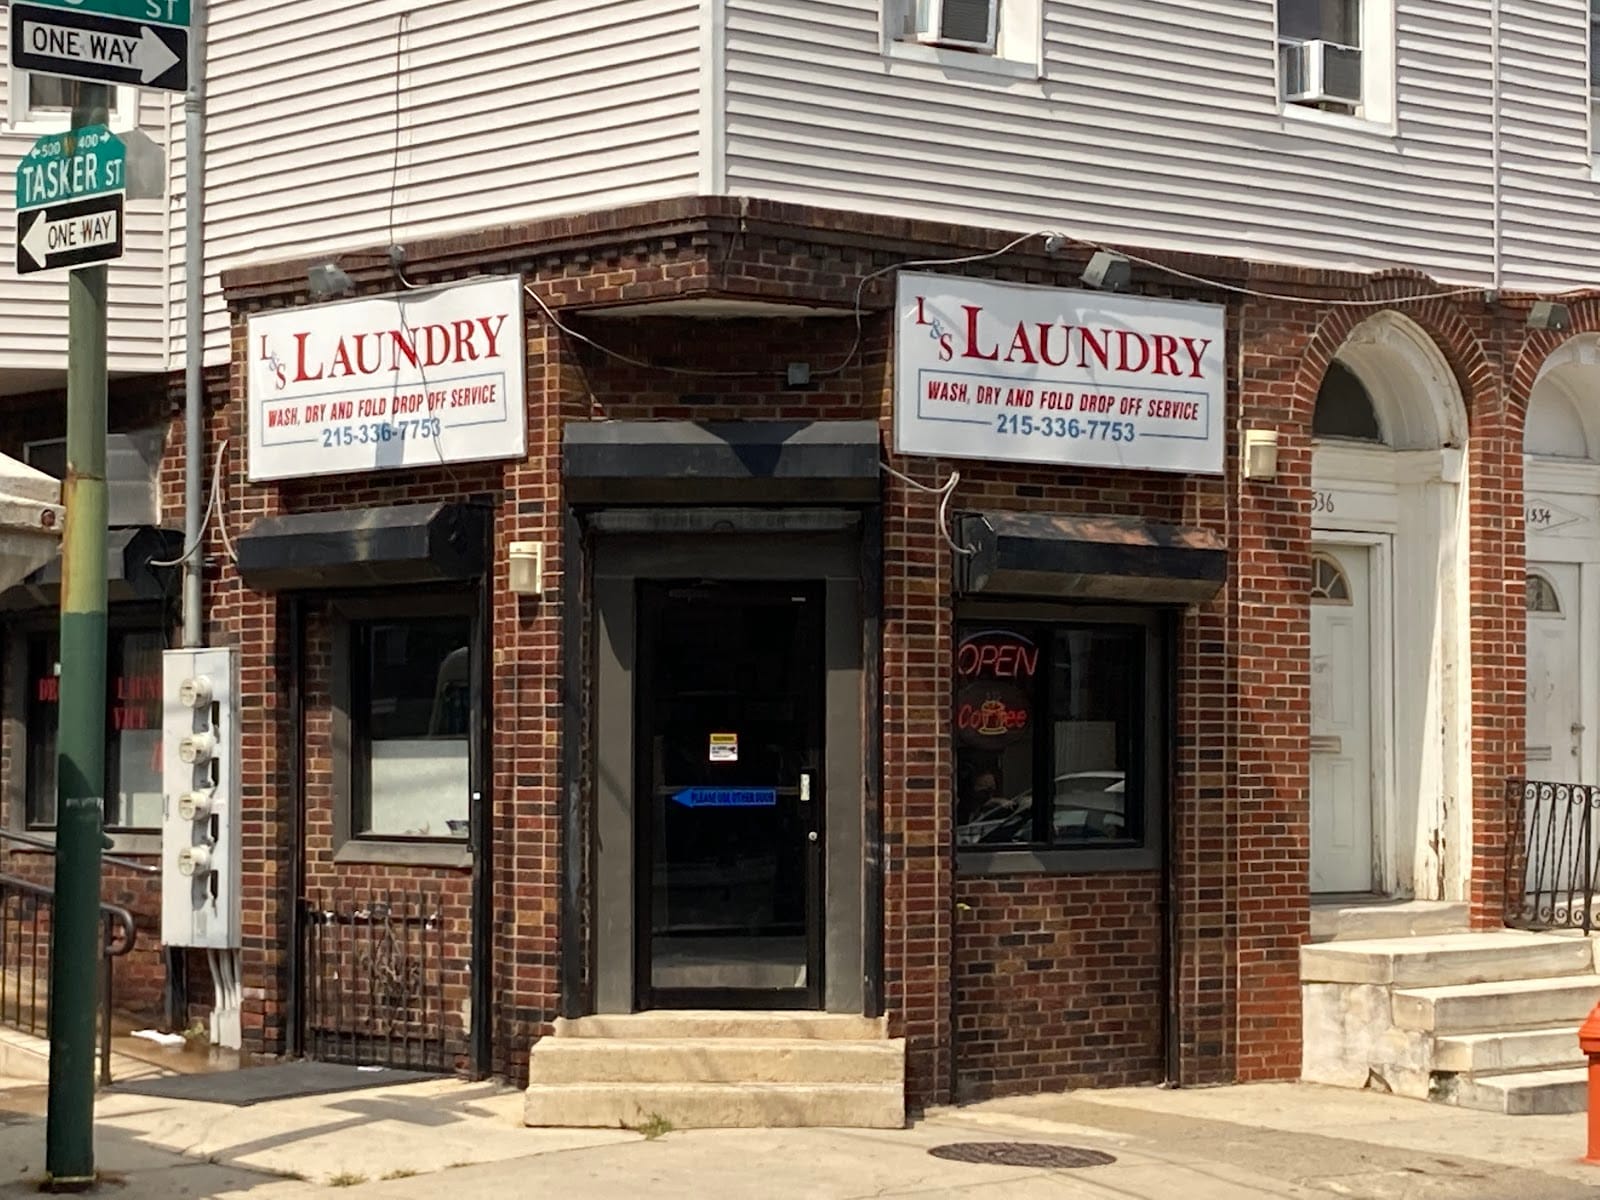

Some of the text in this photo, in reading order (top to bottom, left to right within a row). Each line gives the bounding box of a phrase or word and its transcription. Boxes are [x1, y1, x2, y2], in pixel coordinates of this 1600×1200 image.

[33, 27, 138, 64] ONE WAY
[42, 134, 99, 158] 500 400
[23, 153, 122, 203] TASKER ST
[48, 215, 112, 250] ONE WAY
[292, 314, 509, 383] LAUNDRY
[961, 305, 1212, 379] LAUNDRY
[268, 384, 496, 428] WASH, DRY AND FOLD DROP OFF SERVICE
[928, 380, 1199, 421] WASH, DRY AND FOLD DROP OFF SERVICE
[323, 417, 441, 448] 215-336-7753
[997, 413, 1135, 442] 215-336-7753
[1525, 508, 1552, 525] 1534
[958, 644, 1039, 677] OPEN
